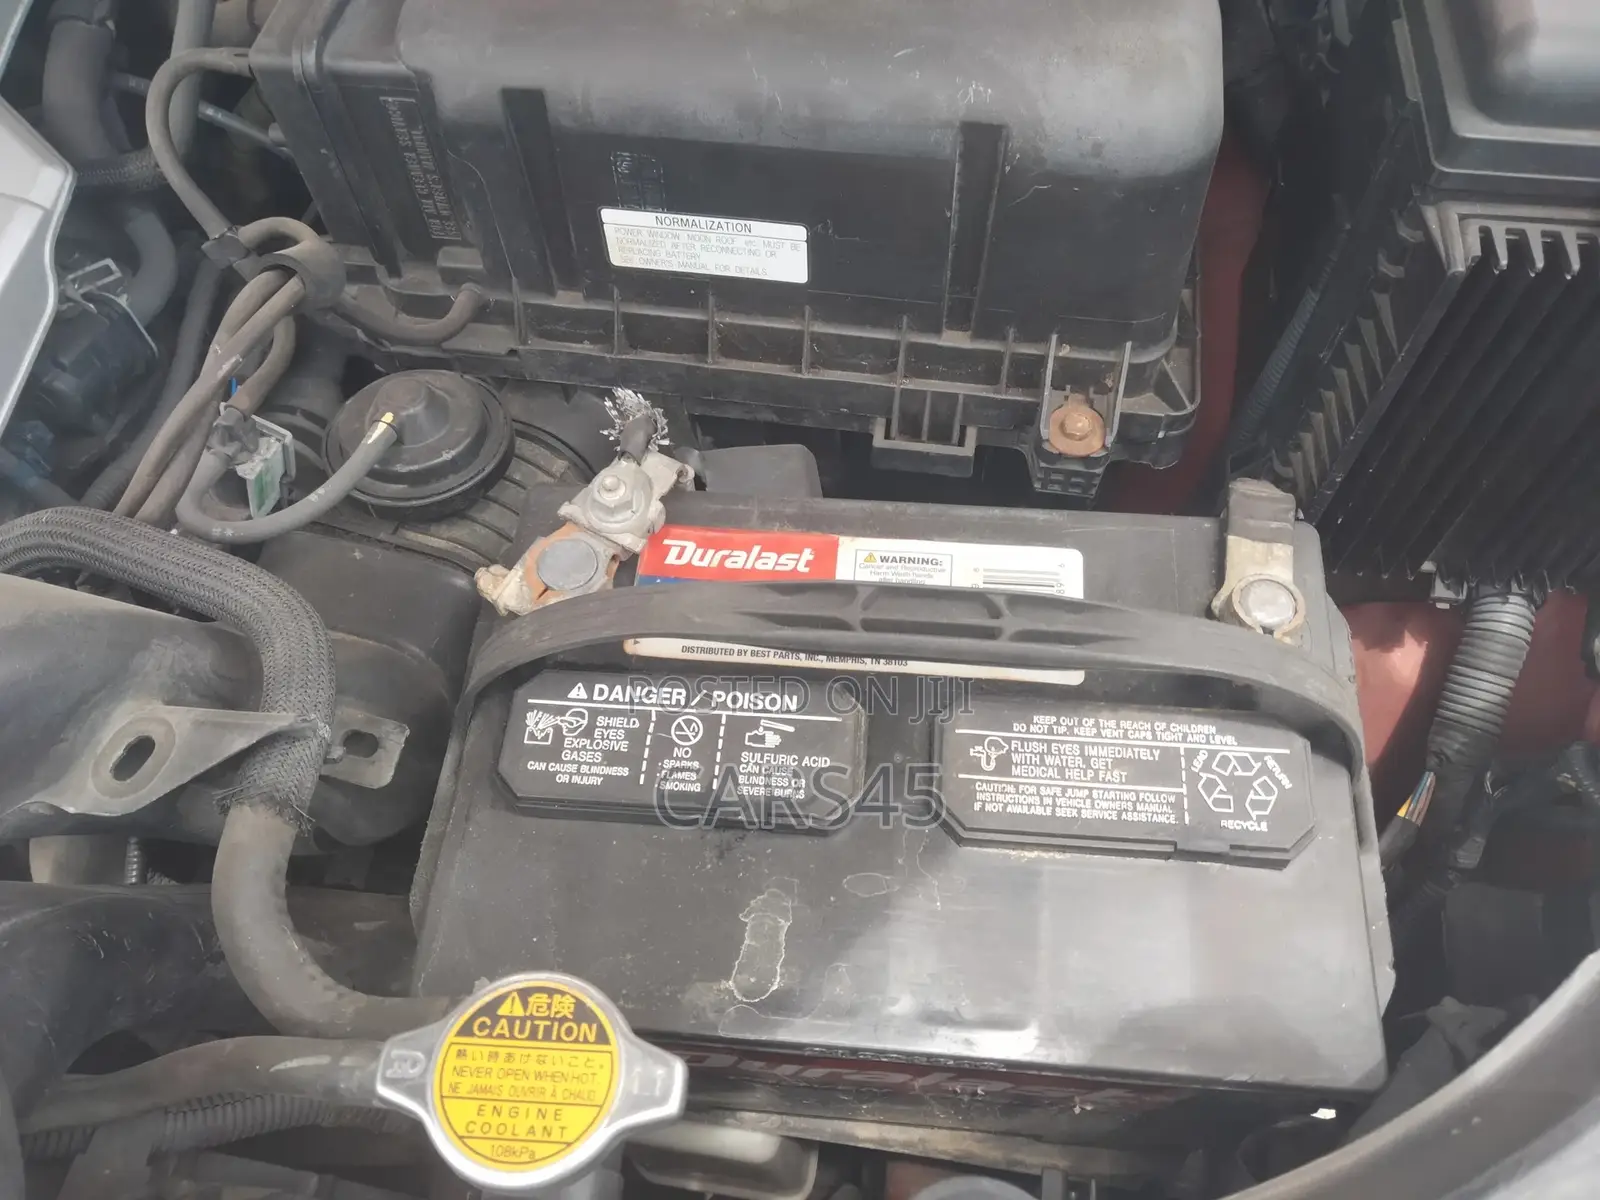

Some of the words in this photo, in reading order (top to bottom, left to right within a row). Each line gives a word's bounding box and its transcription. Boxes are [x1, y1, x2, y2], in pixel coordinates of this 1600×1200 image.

[655, 215, 752, 233] NORMALIZATION
[614, 227, 643, 237] POWER
[763, 240, 785, 249] MUST
[790, 243, 801, 251] BE
[616, 237, 667, 248] NORMALIZED
[671, 242, 696, 251] AFTER
[700, 244, 761, 257] RECONNECTING
[765, 250, 777, 258] OR
[618, 246, 662, 257] REPLACING
[639, 257, 673, 268] OWNER'S
[714, 263, 731, 272] FOR
[662, 538, 815, 573] Duralast
[879, 555, 943, 566] WARNING:
[681, 645, 735, 656] DISTRIBUTED
[737, 649, 748, 657] BY
[751, 649, 772, 658] BEST
[773, 651, 803, 661] PARTS,
[825, 655, 867, 666] MEMPHIS,
[870, 658, 881, 666] TN
[883, 658, 908, 667] 38103
[593, 683, 687, 706] DANGER
[711, 690, 798, 712] POISON
[596, 715, 640, 729] SHIELD
[1033, 715, 1058, 725] KEEP
[1060, 716, 1080, 726] OUT
[1082, 717, 1095, 727] OF
[1099, 718, 1117, 728] THE
[1120, 719, 1151, 731] REACH
[1154, 721, 1167, 731] OF
[1170, 722, 1217, 735] CHILDREN
[593, 727, 625, 740] EYES
[1013, 722, 1027, 732] DO
[1029, 723, 1049, 733] NOT
[1052, 725, 1070, 735] TIP.
[1073, 726, 1097, 736] KEEP
[1100, 728, 1125, 739] VENT
[1127, 729, 1153, 740] CAPS
[1156, 731, 1184, 742] TIGHT
[1187, 733, 1206, 743] AND
[1209, 734, 1238, 746] LEVEL
[563, 737, 630, 752] EXPLOSIVE
[673, 747, 692, 758] NO
[1011, 740, 1048, 753] FLUSH
[1051, 743, 1081, 756] EYES
[1084, 744, 1161, 761] IMMEDIATELY
[561, 751, 603, 763] GASES
[662, 759, 700, 770] SPARKS
[740, 751, 799, 765] SULFURIC
[802, 755, 831, 768] ACID
[1011, 753, 1040, 765] WITH
[1090, 757, 1114, 770] GET
[1190, 749, 1208, 773] LEAD
[527, 760, 546, 771] CAN
[548, 763, 578, 774] CAUSE
[580, 765, 630, 776] BLINDNESS
[660, 770, 697, 781] FLAMES
[739, 763, 760, 774] CAN
[762, 765, 794, 777] CAUSE
[1011, 765, 1061, 779] MEDICAL
[1065, 769, 1095, 781] HELP
[1099, 770, 1128, 784] FAST
[1263, 755, 1293, 790] RETURN
[555, 773, 569, 784] OR
[571, 775, 604, 786] INJURY
[659, 781, 701, 792] SMOKING
[738, 775, 789, 786] BLINDNESS
[791, 778, 806, 789] OR
[737, 786, 772, 797] SEVERE
[773, 787, 805, 799] BURNS
[975, 781, 1016, 794] CAUTION:
[1018, 785, 1037, 795] FOR
[1040, 786, 1062, 797] SAFE
[1065, 788, 1090, 799] JUMP
[1092, 789, 1137, 802] STARTING
[1139, 792, 1176, 804] FOLLOW
[976, 791, 1041, 806] INSTRUCTIONS
[1043, 796, 1053, 806] IN
[1055, 797, 1092, 809] VEHICLE
[1094, 799, 1134, 811] OWNERS
[973, 801, 983, 811] IF
[984, 802, 1004, 812] NOT
[1006, 804, 1053, 816] AVAILABLE
[1055, 807, 1078, 818] SEEK
[1080, 809, 1118, 821] SERVICE
[1121, 811, 1179, 825] ASSISTANCE.
[1220, 819, 1269, 832] RECYCLE
[525, 992, 577, 1019] 危険
[472, 1016, 598, 1043] CAUTION
[452, 1065, 493, 1079] NEVER
[496, 1067, 530, 1081] OPEN
[534, 1070, 569, 1083] WHEN
[448, 1081, 462, 1094] NE
[466, 1083, 504, 1097] JAMAIS
[508, 1085, 547, 1098] OUVRIR
[476, 1104, 565, 1122] ENGINE
[465, 1120, 569, 1139] COOLANT
[490, 1144, 537, 1160] 108kPa
